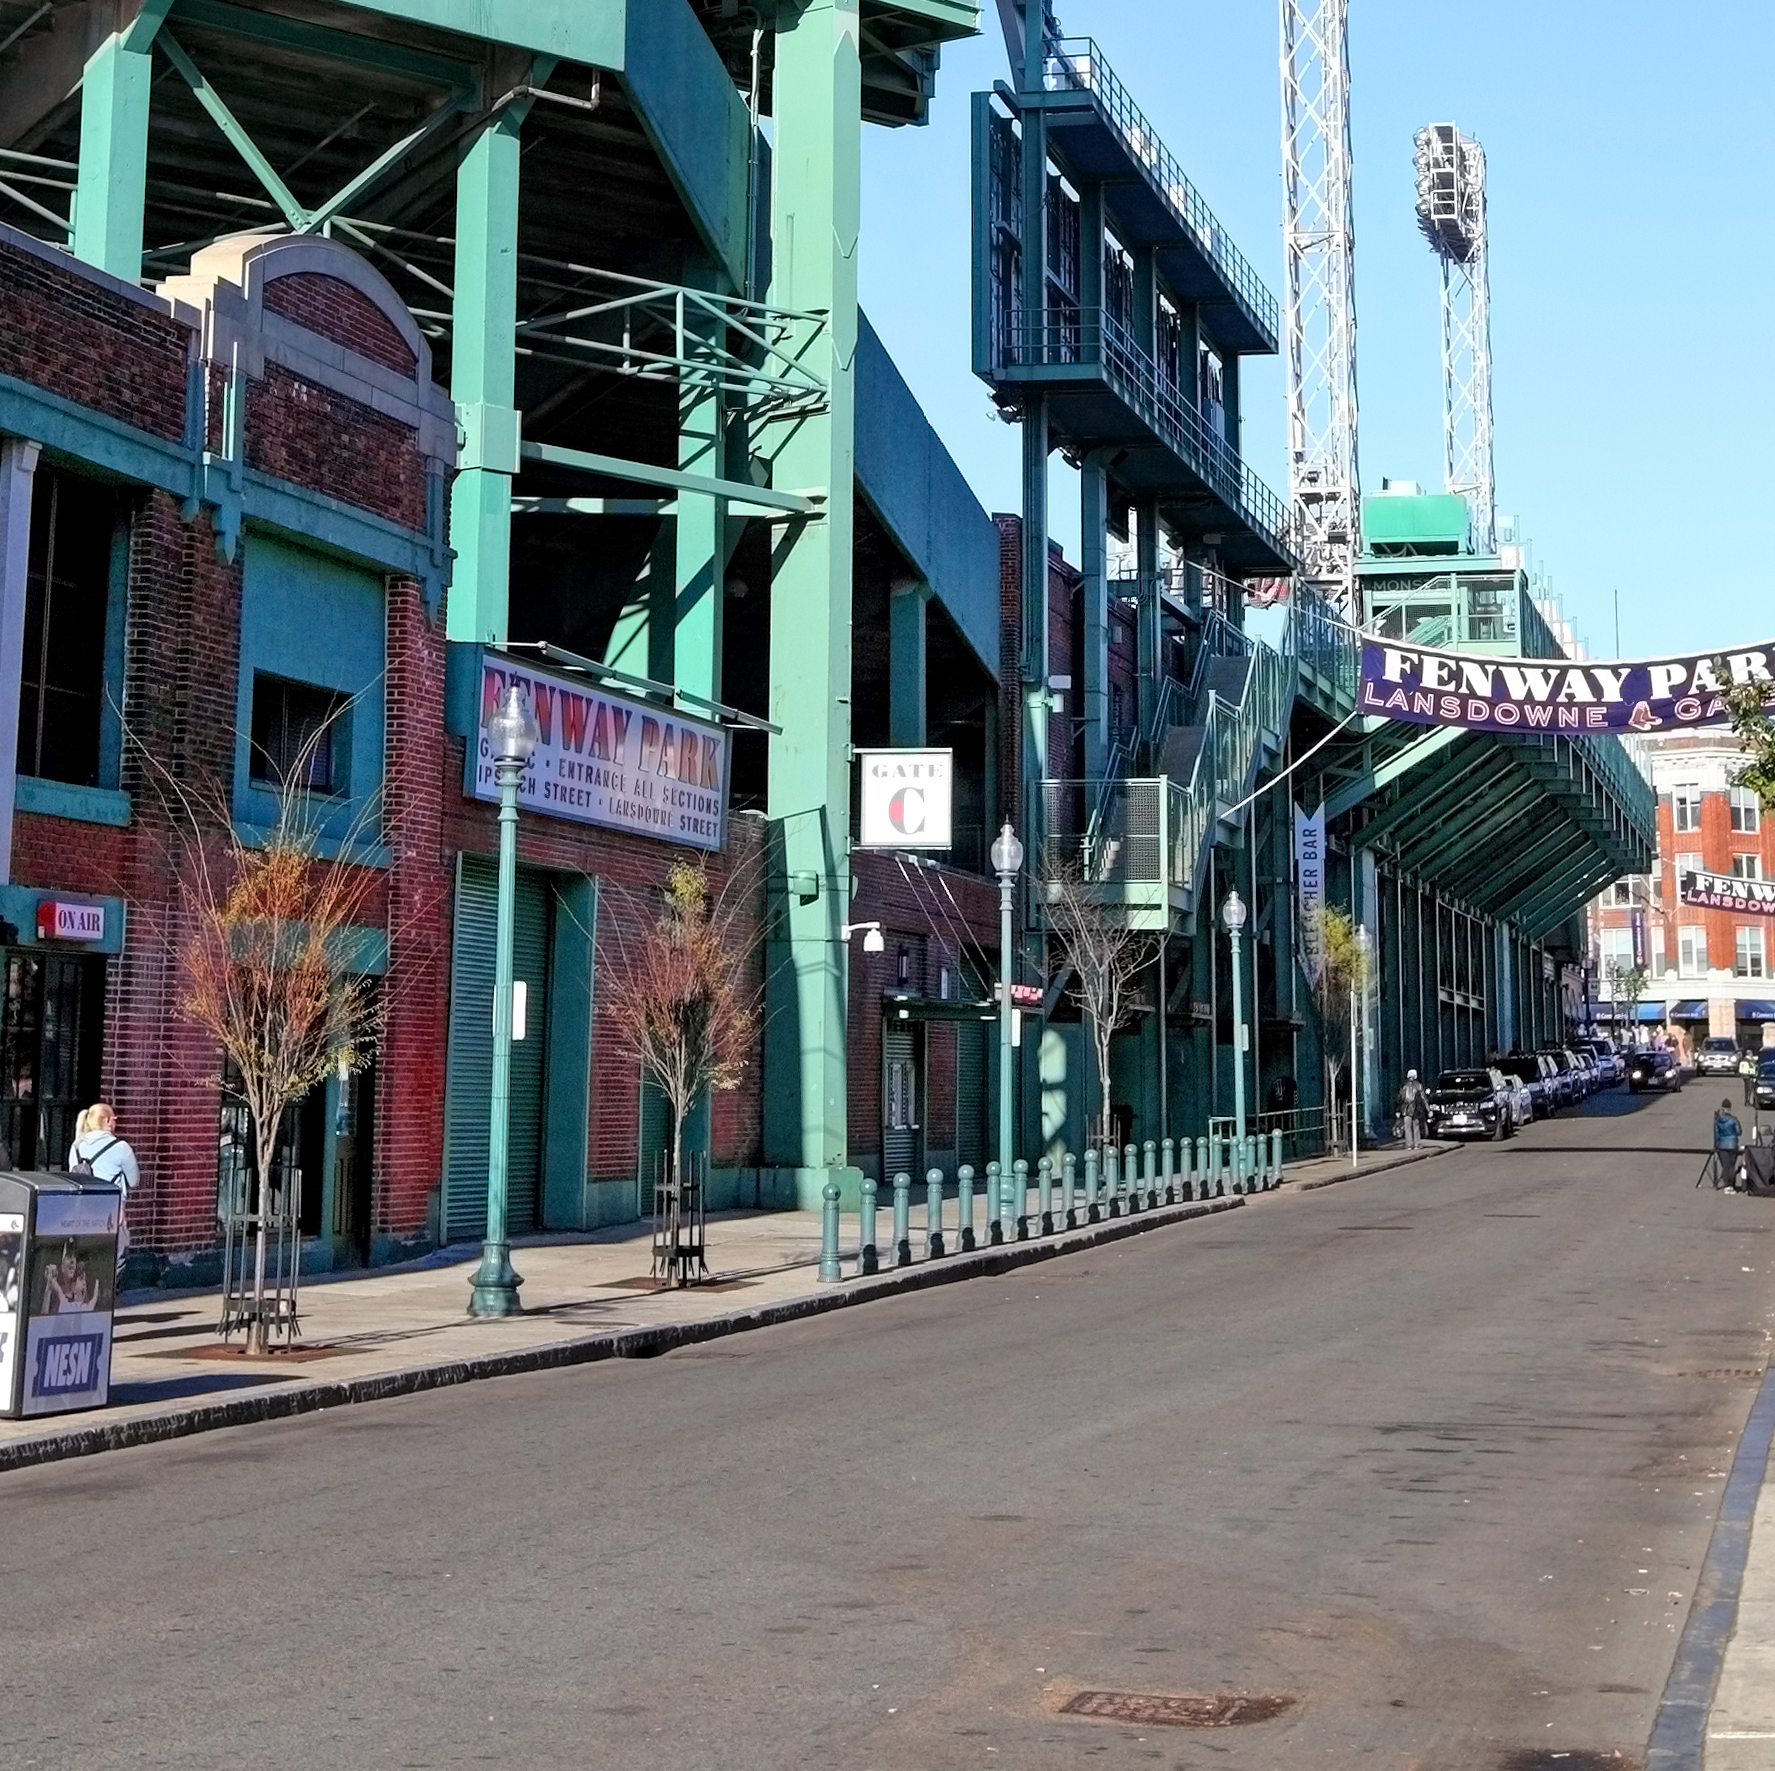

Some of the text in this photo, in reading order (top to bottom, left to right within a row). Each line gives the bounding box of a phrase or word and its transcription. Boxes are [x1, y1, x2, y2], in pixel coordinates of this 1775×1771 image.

[1382, 645, 1632, 703] FENWAY
[1364, 682, 1608, 728] LANSDOWNE
[638, 714, 722, 793] PARK
[871, 763, 943, 779] GATE
[478, 764, 719, 838] IPSCH STREET LANSDOWNE STREET
[558, 757, 627, 793] ENTRANCE
[633, 779, 656, 801] ALL
[662, 786, 720, 818] SECTIONS
[889, 786, 926, 836] C
[1302, 828, 1318, 861] BAR
[58, 910, 101, 932] ON AIR
[43, 1341, 93, 1388] NESN
